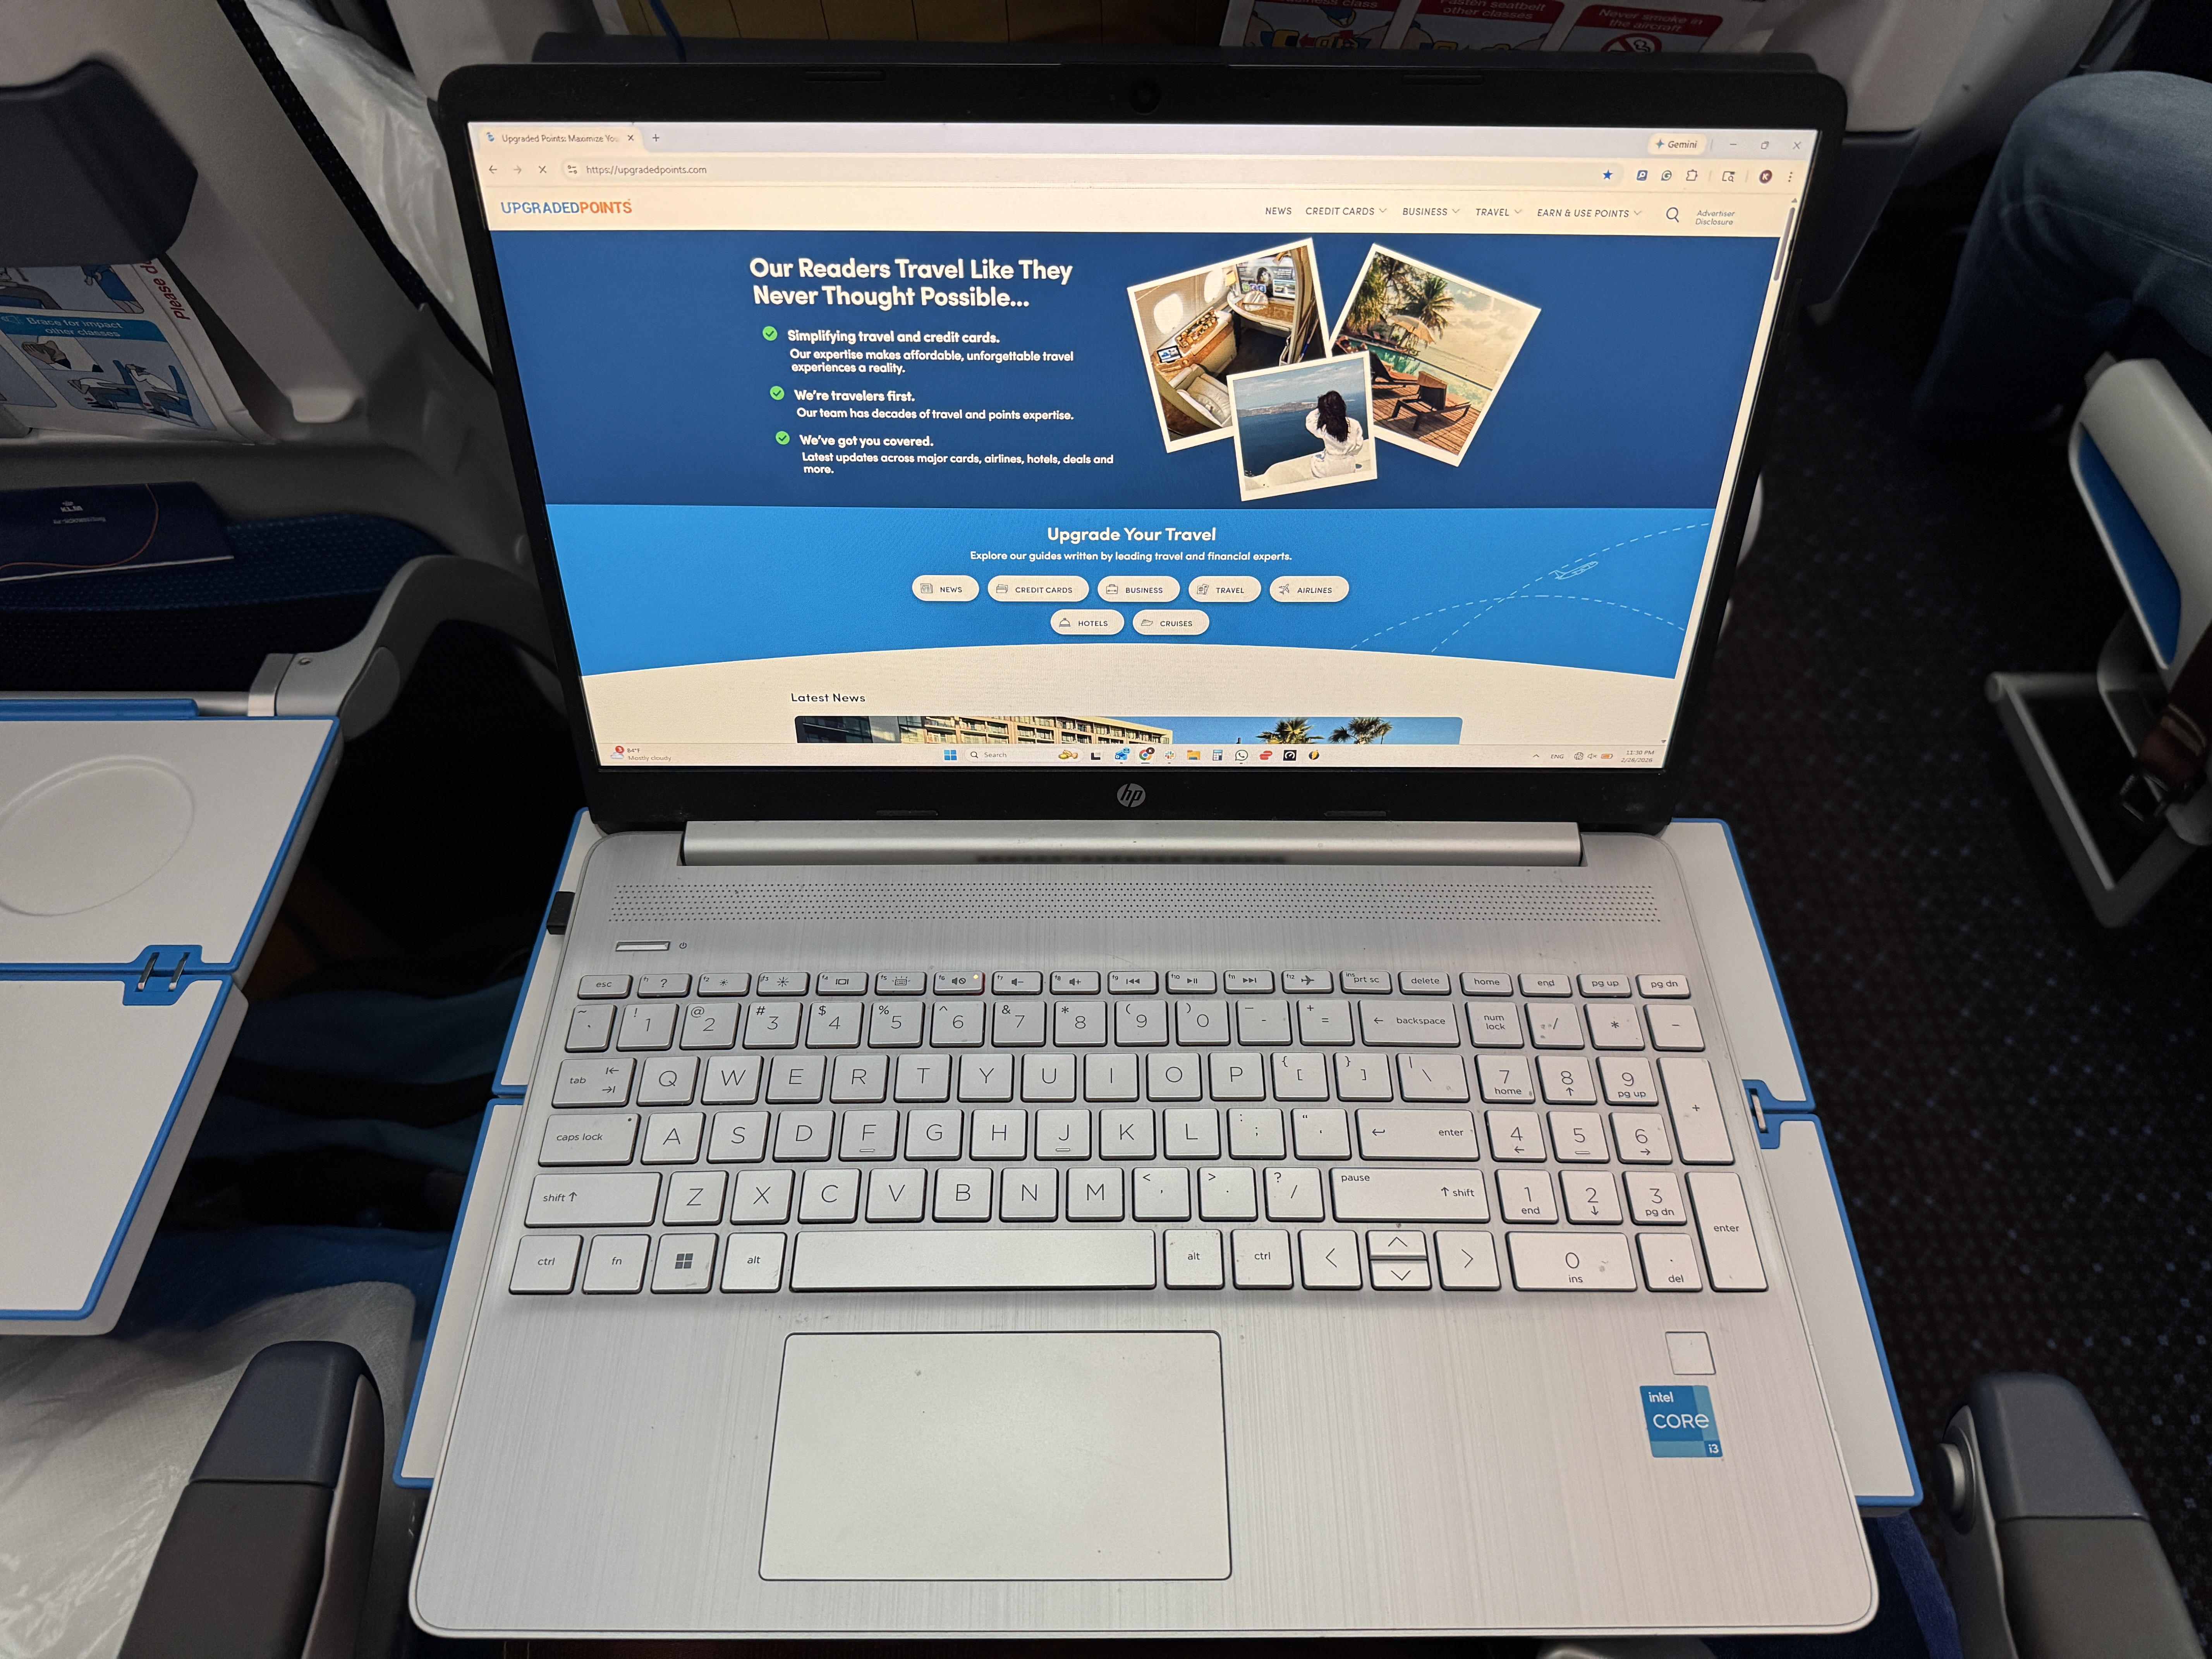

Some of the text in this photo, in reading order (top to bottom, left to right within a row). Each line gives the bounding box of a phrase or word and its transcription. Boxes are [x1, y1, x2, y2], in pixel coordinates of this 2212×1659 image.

[1490, 1, 1546, 11] seatbelt
[1482, 10, 1533, 19] classes
[1599, 9, 1640, 19] Never
[1642, 14, 1687, 24] smoke
[1609, 19, 1683, 32] the aircraft
[502, 135, 539, 144] Upgraded
[1668, 140, 1697, 148] Gemini
[586, 165, 707, 176] https://upgradedpoints.com
[501, 201, 632, 214] UPGRADEDPOINTS
[1305, 207, 1374, 215] CREDIT CARDS
[1403, 208, 1448, 216] BUSINESS
[1537, 209, 1562, 217] EARN
[1595, 210, 1629, 218] POINTS
[750, 258, 1073, 285] Our Readers Travel Like They
[153, 278, 191, 320] Please
[753, 285, 1029, 311] Never Thought Possible...
[26, 317, 62, 326] Brace
[81, 321, 123, 329] impact
[77, 329, 121, 337] classes
[787, 329, 1000, 345] Simplifying travel and credit cards.
[790, 348, 1073, 364] Our expertise makes affordable, unforgettable travel
[791, 362, 905, 375] experiences a reality.
[831, 390, 885, 402] travelers
[886, 390, 915, 402] first.
[797, 407, 1074, 422] Our team has decades of travel and points expertise.
[838, 436, 858, 448] got
[859, 438, 881, 448] you
[883, 435, 934, 447] covered.
[802, 452, 834, 462] Latest
[836, 452, 879, 464] updates
[917, 453, 948, 465] major
[950, 453, 982, 464] cards,
[984, 454, 1025, 465] airlines,
[1027, 454, 1061, 465] hotels,
[1063, 454, 1091, 464] deals
[1093, 454, 1114, 464] and
[1048, 527, 1216, 544] Upgrade Your Travel
[970, 551, 1008, 562] Explore
[1029, 551, 1062, 562] guides
[1063, 551, 1098, 560] written
[1101, 551, 1113, 562] by
[1115, 551, 1152, 563] leading
[1154, 551, 1183, 560] travel
[1185, 551, 1205, 560] and
[1207, 551, 1250, 560] financial
[1253, 552, 1292, 562] experts.
[791, 693, 866, 702] Latest News
[1117, 783, 1146, 808] hp
[1352, 975, 1367, 983] prt
[1396, 1017, 1445, 1025] backspace
[1453, 1188, 1475, 1197] shift
[543, 1194, 566, 1202] shift
[1521, 1206, 1540, 1214] end
[747, 1255, 761, 1264] alt
[1188, 1252, 1200, 1260] alt
[1254, 1252, 1271, 1260] ctrl
[538, 1257, 555, 1266] ctrl
[612, 1257, 622, 1265] fn
[1568, 1275, 1583, 1283] ins
[1668, 1274, 1684, 1283] del
[1648, 1391, 1674, 1402] intel
[1708, 1444, 1719, 1453] i3
